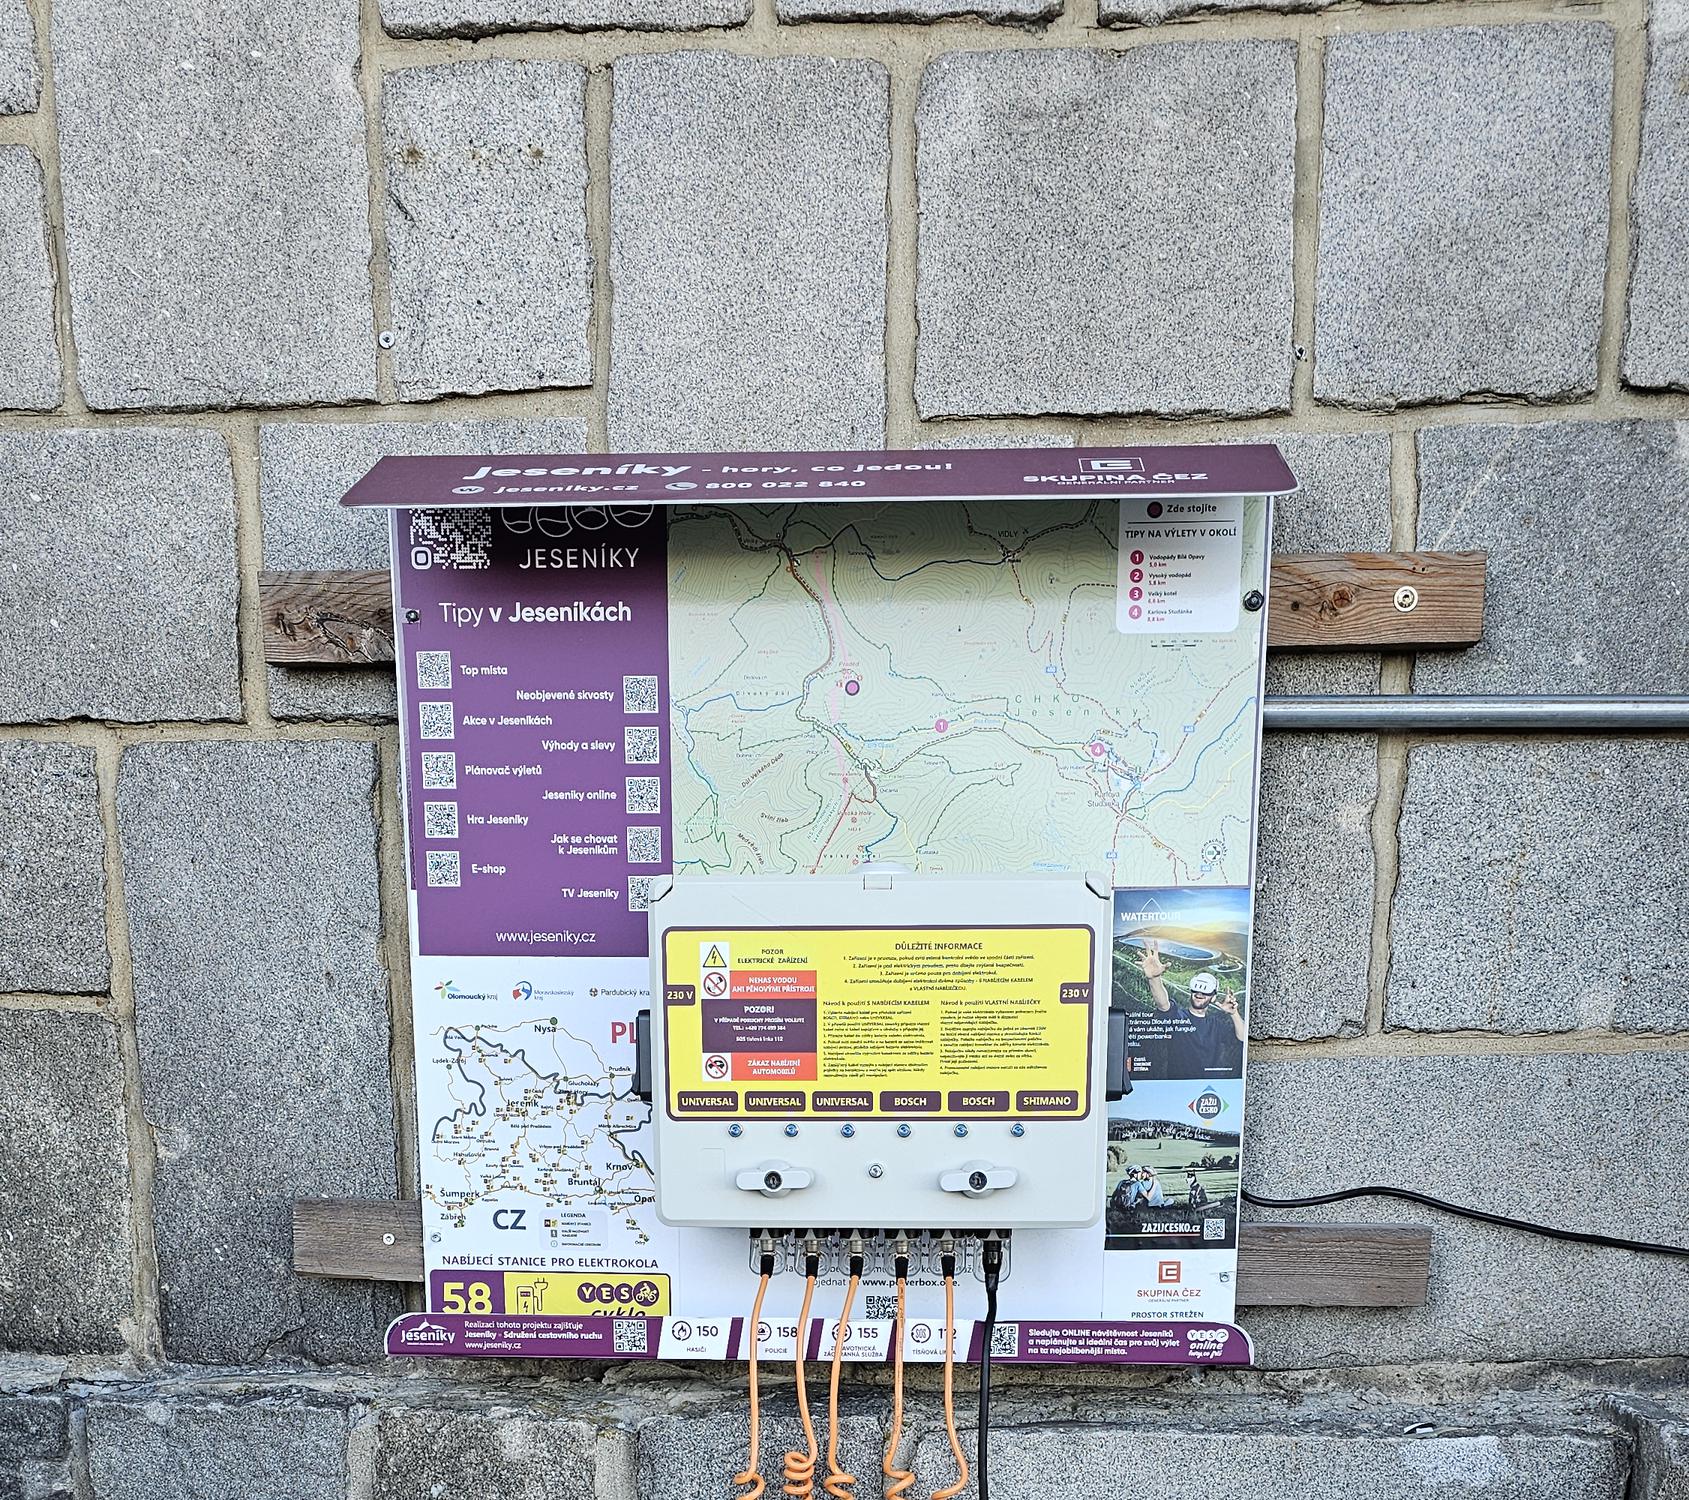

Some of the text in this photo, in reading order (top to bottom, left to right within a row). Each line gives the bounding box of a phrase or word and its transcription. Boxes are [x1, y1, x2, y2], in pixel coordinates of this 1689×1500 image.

[462, 464, 692, 480] Jeseníky
[1023, 472, 1209, 483] SKUPINA ČEZ
[705, 480, 867, 489] 800 022 840
[1166, 503, 1217, 514] Zde stojíte
[1125, 526, 1237, 539] TIPY NA VÝLETY V OKOLÍ
[519, 543, 639, 569] JESENÍKY
[1133, 572, 1140, 581] 2
[1133, 590, 1139, 598] 3
[438, 601, 632, 628] Tipy v Jeseníkách
[1132, 608, 1138, 617] 4
[460, 664, 508, 677] Top místa
[516, 689, 614, 702] Neobjevené skvosty
[462, 715, 553, 726] Akce v Jeseníkách
[541, 739, 616, 752] Výhody a slevy
[464, 764, 542, 777] Plánovač výletů
[586, 789, 617, 800] online
[466, 814, 485, 825] Hra
[551, 833, 618, 844] Jak se chovat
[558, 845, 565, 855] k
[471, 863, 506, 876] E-shop
[561, 888, 574, 898] TV
[496, 930, 596, 944] www.jeseniky.cz
[895, 941, 983, 951] DŮLEŽITÉ INFORMACE
[447, 993, 485, 1001] Olomoucký
[600, 988, 650, 997] Pardubický kra
[667, 991, 693, 999] 230 V
[1062, 989, 1089, 998] 230 V
[744, 1006, 775, 1014] POZOR!
[534, 1025, 557, 1034] Nysa
[681, 1097, 734, 1106] UNIVERSAL
[749, 1097, 802, 1106] UNIVERSAL
[816, 1097, 870, 1106] UNIVERSAL
[894, 1097, 927, 1106] BOSCH
[962, 1096, 995, 1106] BOSCH
[1023, 1096, 1072, 1106] SHIMANO
[440, 1188, 480, 1199] Šumperk
[493, 1209, 526, 1230] CZ
[442, 1253, 659, 1269] NABÍJECÍ STANICE PRO ELEKTROKOLA
[442, 1282, 493, 1314] 58
[1136, 1287, 1201, 1298] SKUPINA ČEZ
[1170, 1310, 1204, 1318] STREŽEN
[464, 1320, 495, 1329] Realizaci
[496, 1320, 521, 1329] tohoto
[522, 1321, 551, 1331] projektu
[696, 1325, 719, 1337] 150
[401, 1329, 455, 1343] Jeseníky
[503, 1330, 537, 1339] Sdružení
[538, 1331, 579, 1340] cestovního
[580, 1331, 603, 1340] ruchu
[776, 1326, 798, 1338] 158
[857, 1327, 879, 1339] 155
[937, 1328, 957, 1339] 12
[1028, 1328, 1060, 1337] Sledujte
[1061, 1328, 1091, 1337] ONLINE
[1091, 1328, 1138, 1337] návštěvnost
[1035, 1338, 1077, 1347] naplánujte
[1114, 1337, 1128, 1346] čas
[1129, 1340, 1142, 1348] pro
[1143, 1338, 1159, 1348] svůj
[1160, 1338, 1180, 1348] výlet
[1189, 1341, 1224, 1350] online
[1104, 1347, 1128, 1355] místa.
